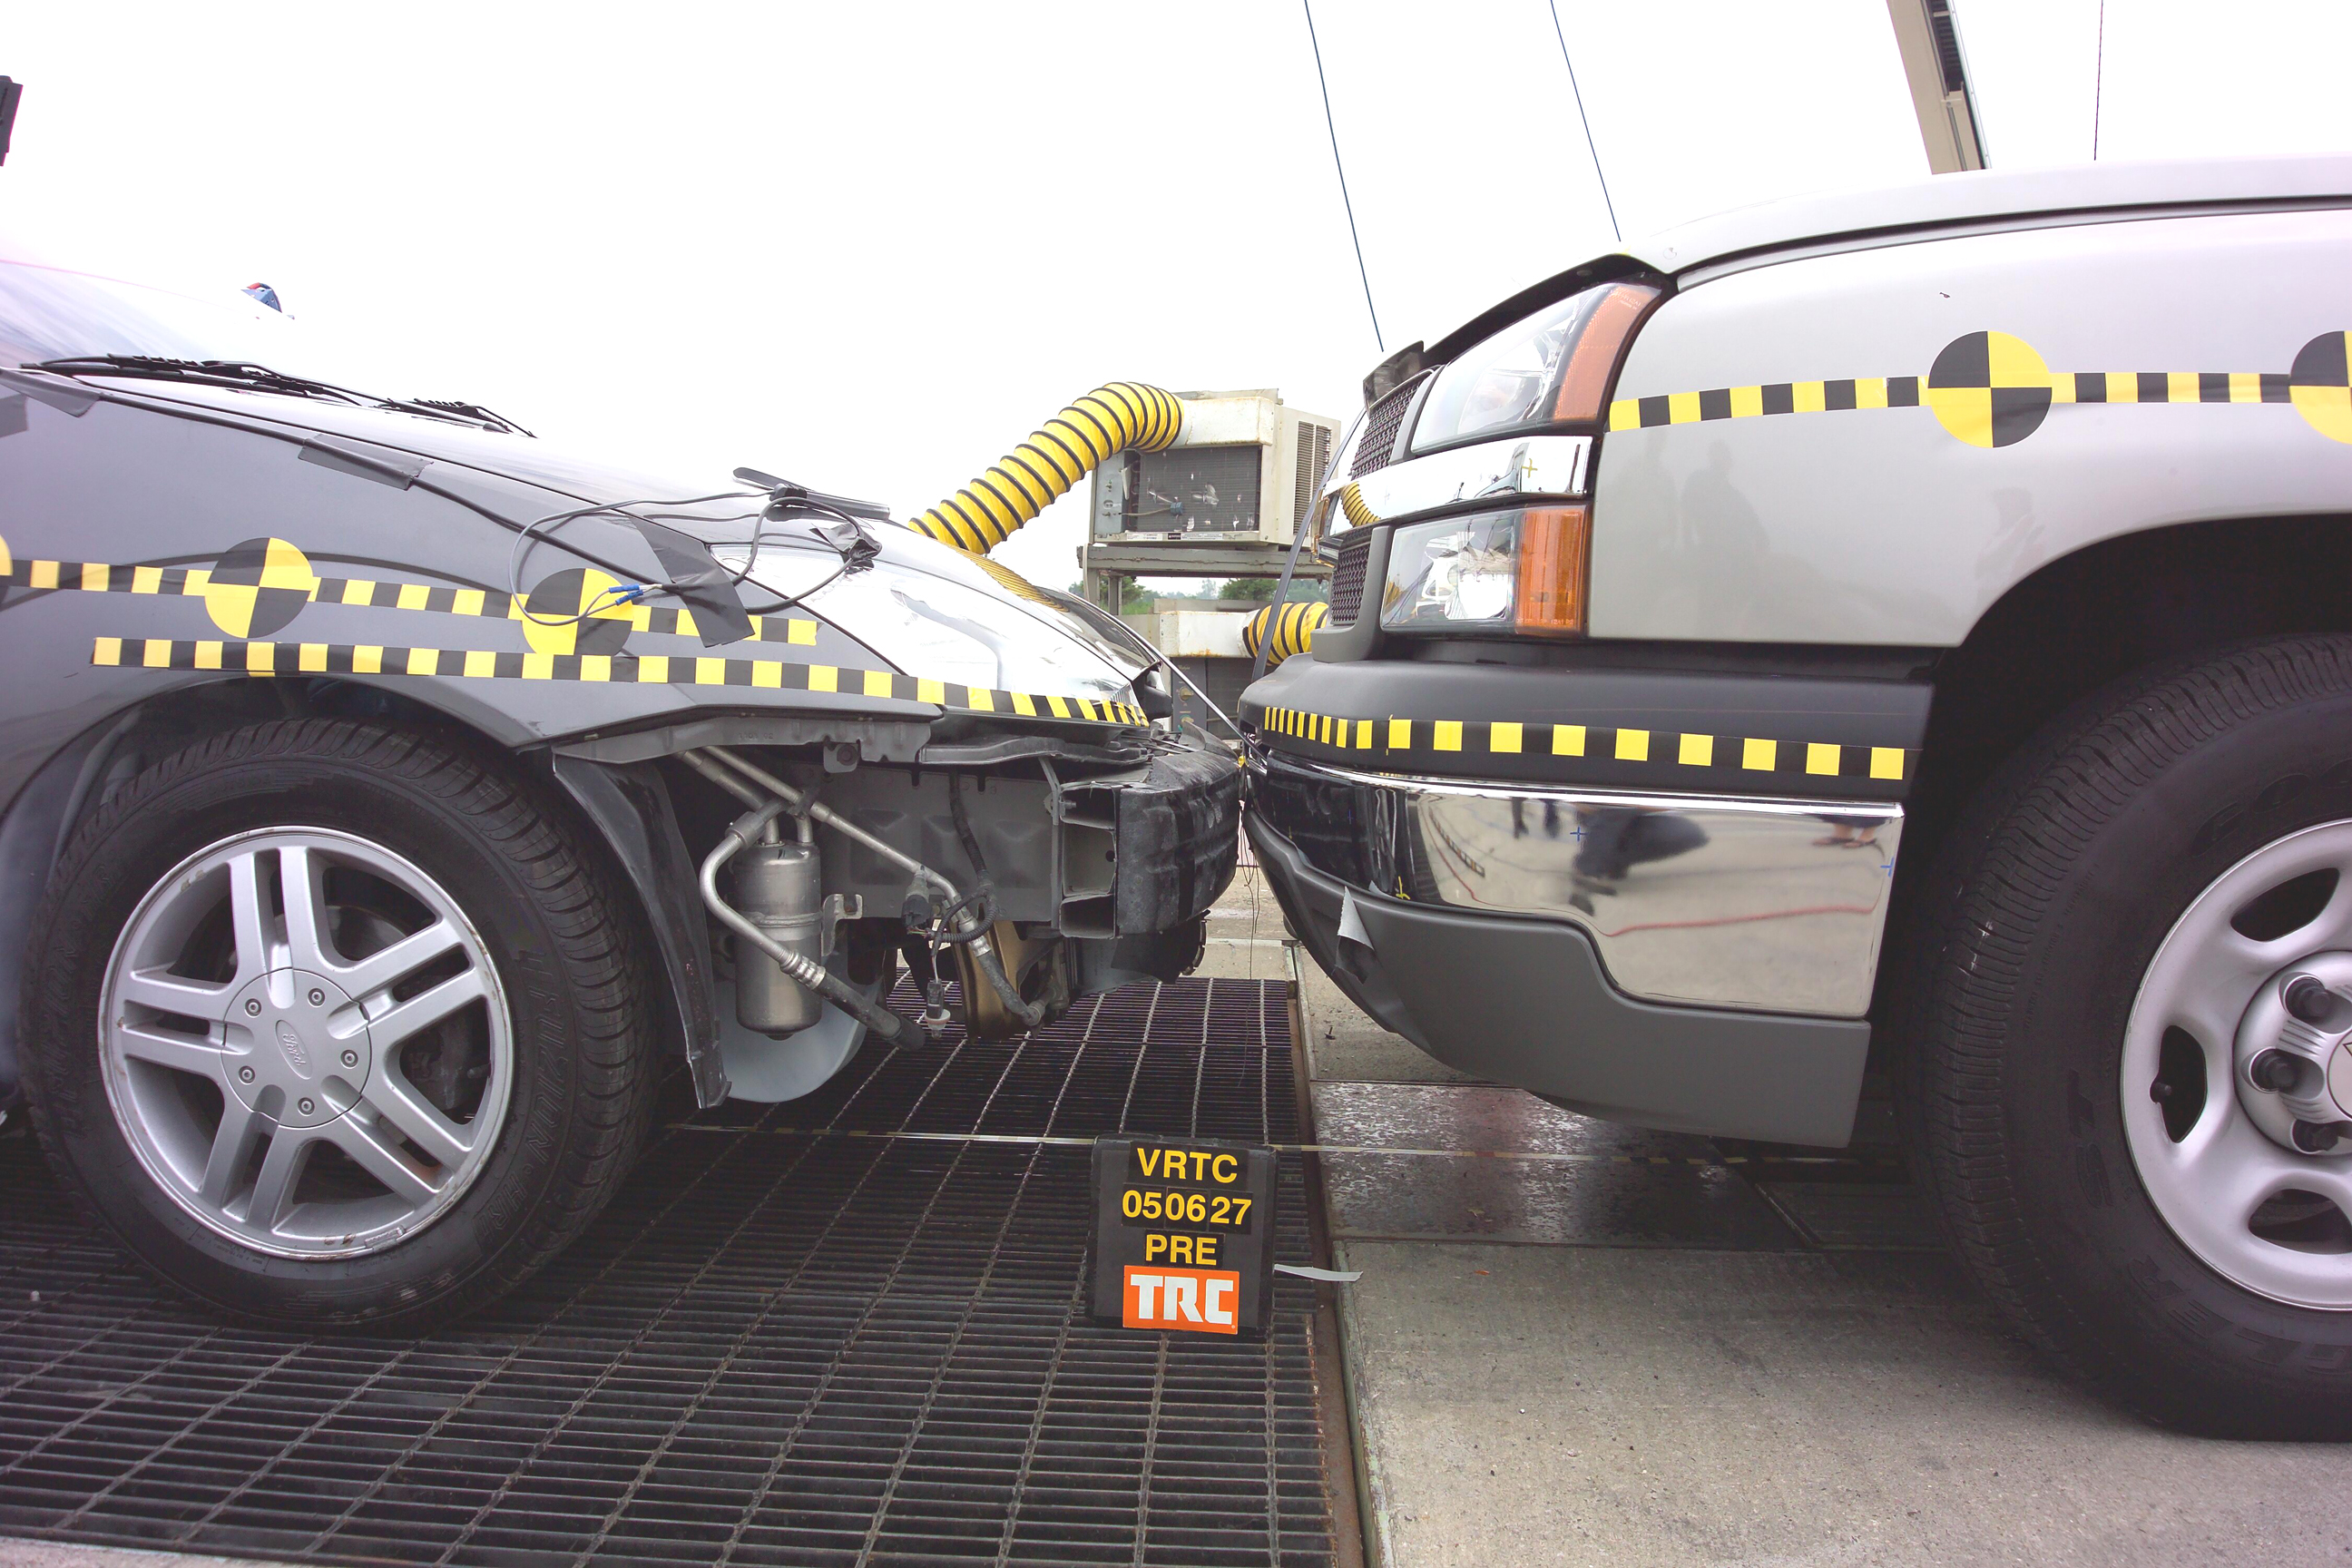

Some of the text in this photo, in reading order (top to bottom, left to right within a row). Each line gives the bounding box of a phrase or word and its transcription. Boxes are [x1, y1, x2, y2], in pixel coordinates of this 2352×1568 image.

[282, 1034, 307, 1066] Ford
[525, 984, 566, 1165] FUZION
[1137, 1148, 1238, 1183] VRTC
[1122, 1190, 1251, 1225] 050627
[1145, 1234, 1217, 1266] PRE
[1131, 1274, 1234, 1325] TRC
